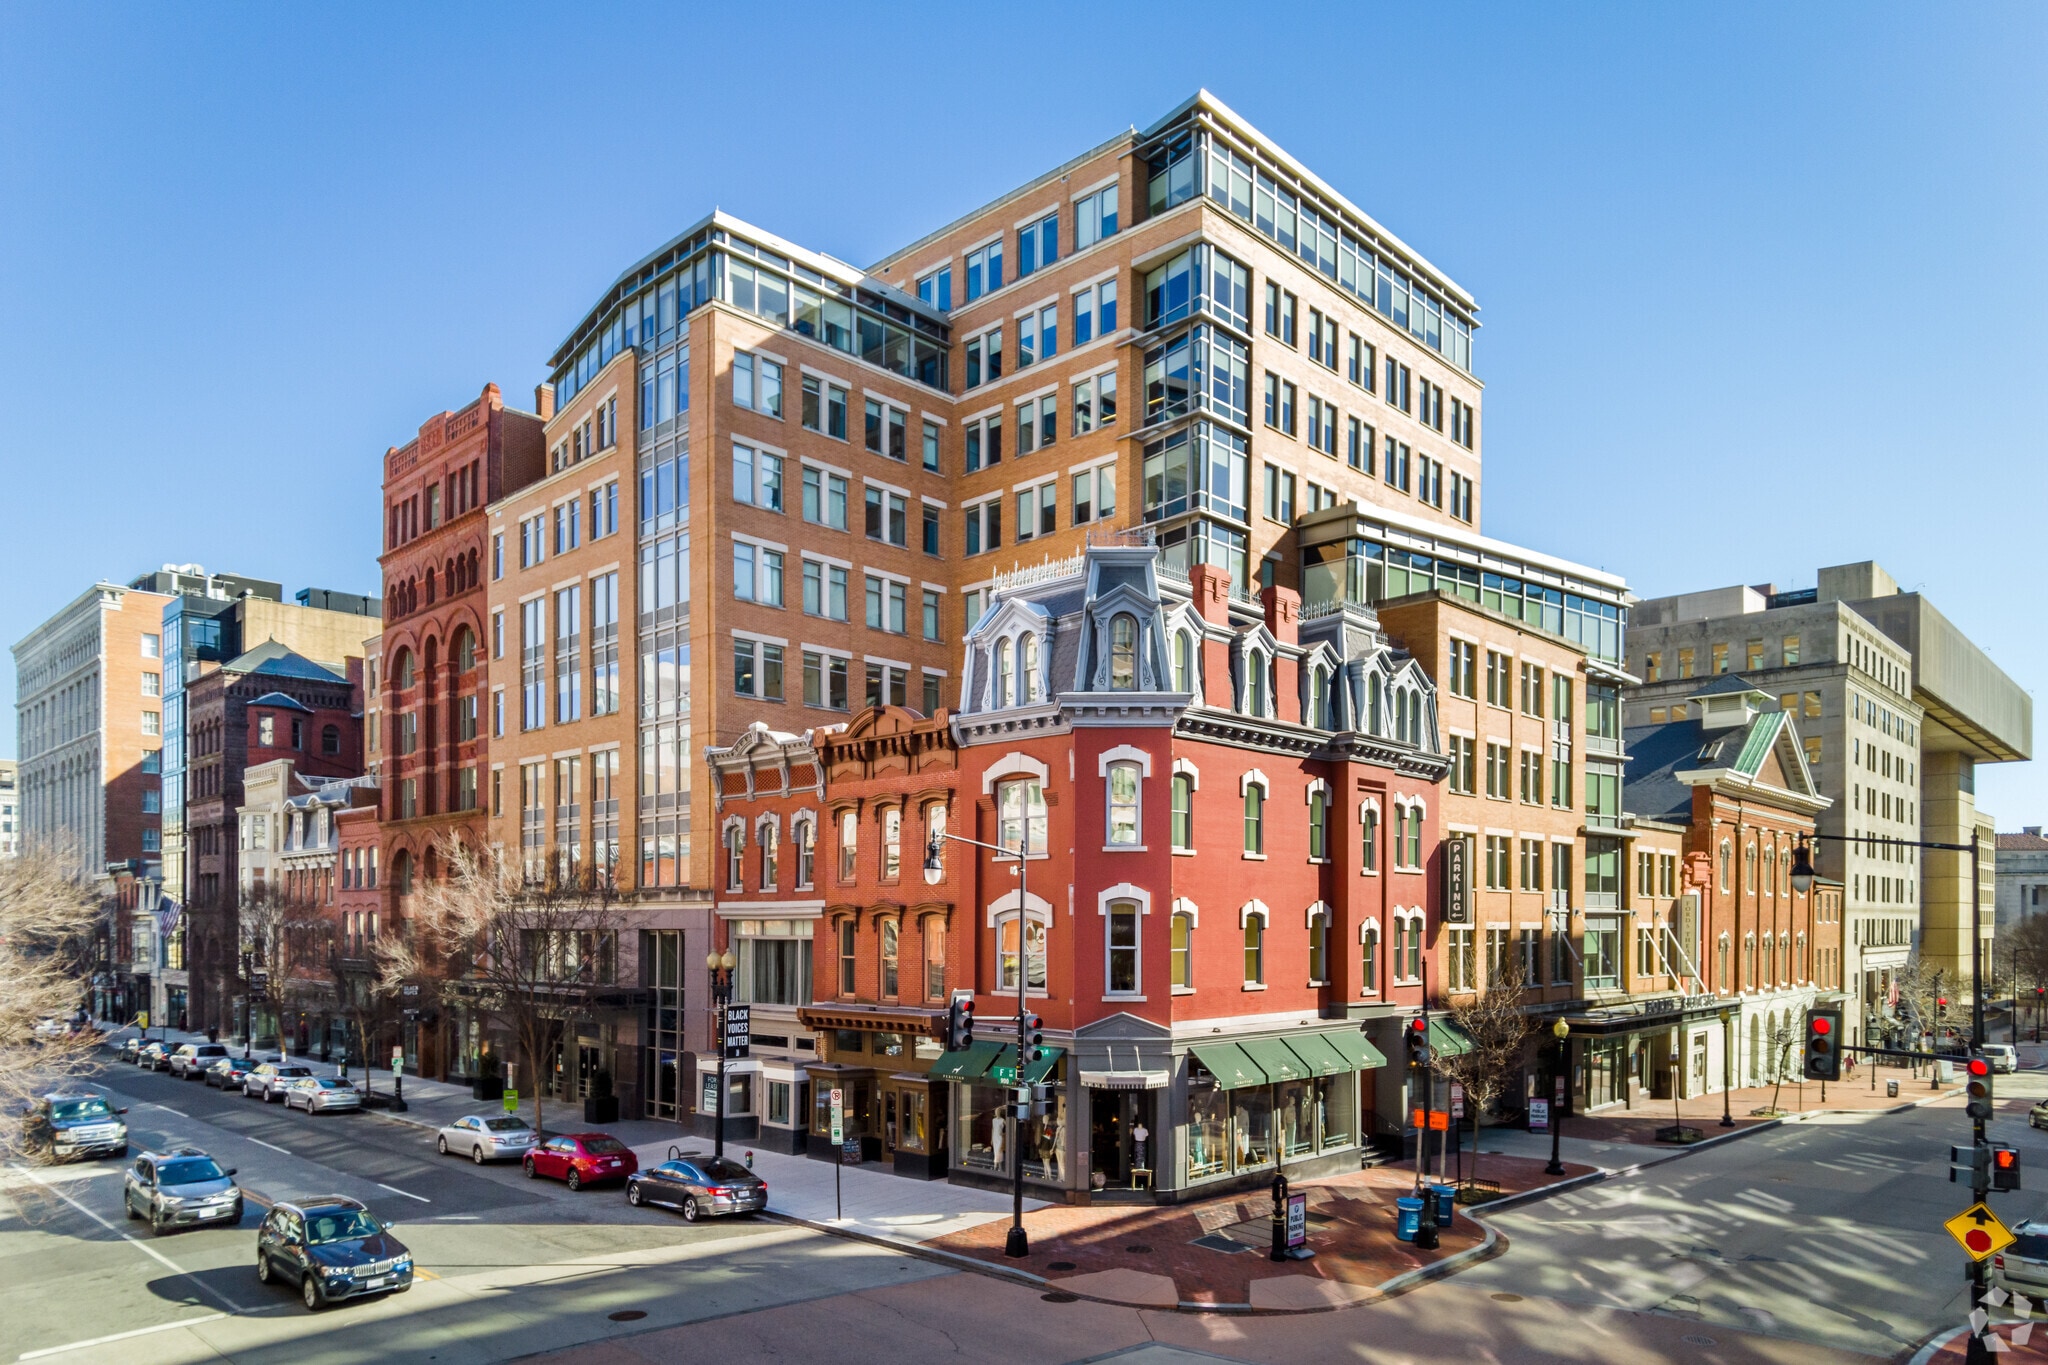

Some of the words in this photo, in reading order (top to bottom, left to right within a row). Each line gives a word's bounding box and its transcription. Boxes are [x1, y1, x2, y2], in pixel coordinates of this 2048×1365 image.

[1453, 844, 1461, 911] PARKING
[728, 1010, 748, 1021] BLACK
[728, 1023, 748, 1034] VOICES
[727, 1036, 748, 1047] MATTER
